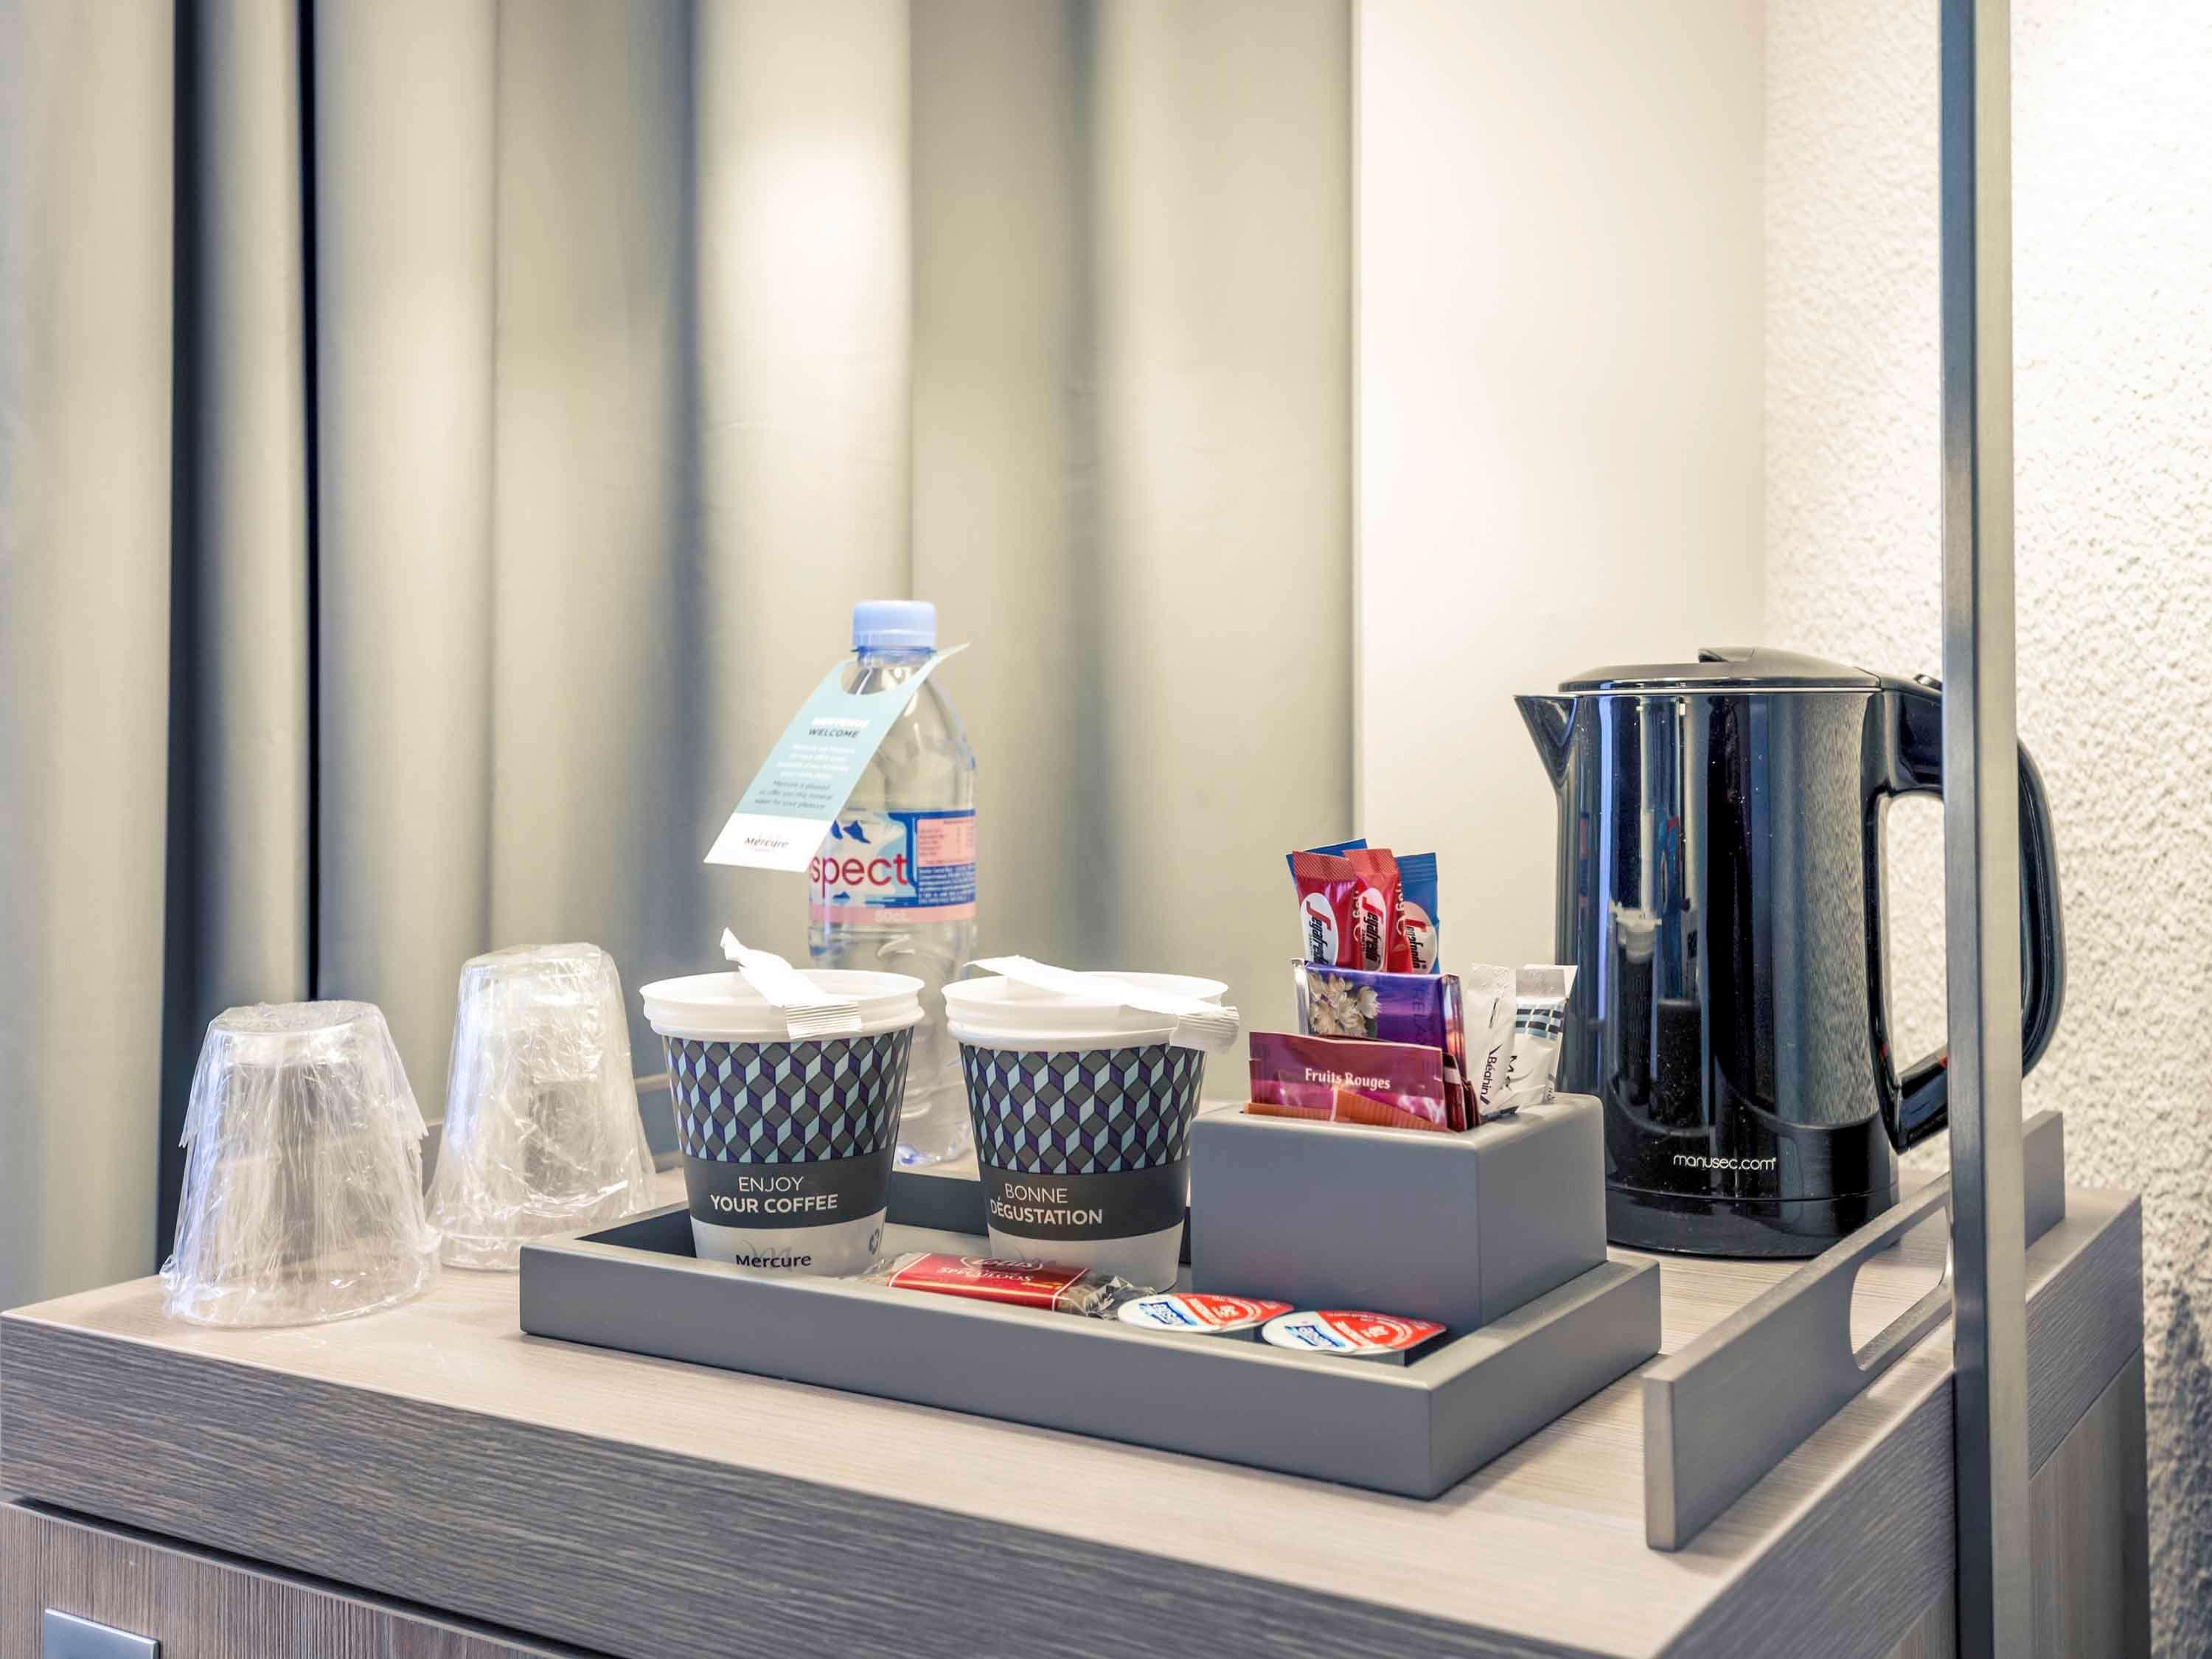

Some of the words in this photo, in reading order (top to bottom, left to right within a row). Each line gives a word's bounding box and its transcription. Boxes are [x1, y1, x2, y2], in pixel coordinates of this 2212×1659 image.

[808, 727, 859, 738] WELCOME
[1362, 896, 1384, 963] Segafredo
[1305, 1068, 1342, 1085] Fruits
[1344, 1072, 1391, 1091] Rouges
[1673, 1155, 1775, 1170] manusec.com
[739, 1177, 804, 1192] ENJOY
[1005, 1183, 1068, 1203] BONNE
[710, 1194, 759, 1213] YOUR
[764, 1194, 838, 1213] COFFEE
[990, 1197, 1102, 1225] DÉGUSTATION
[736, 1255, 812, 1268] Mercure
